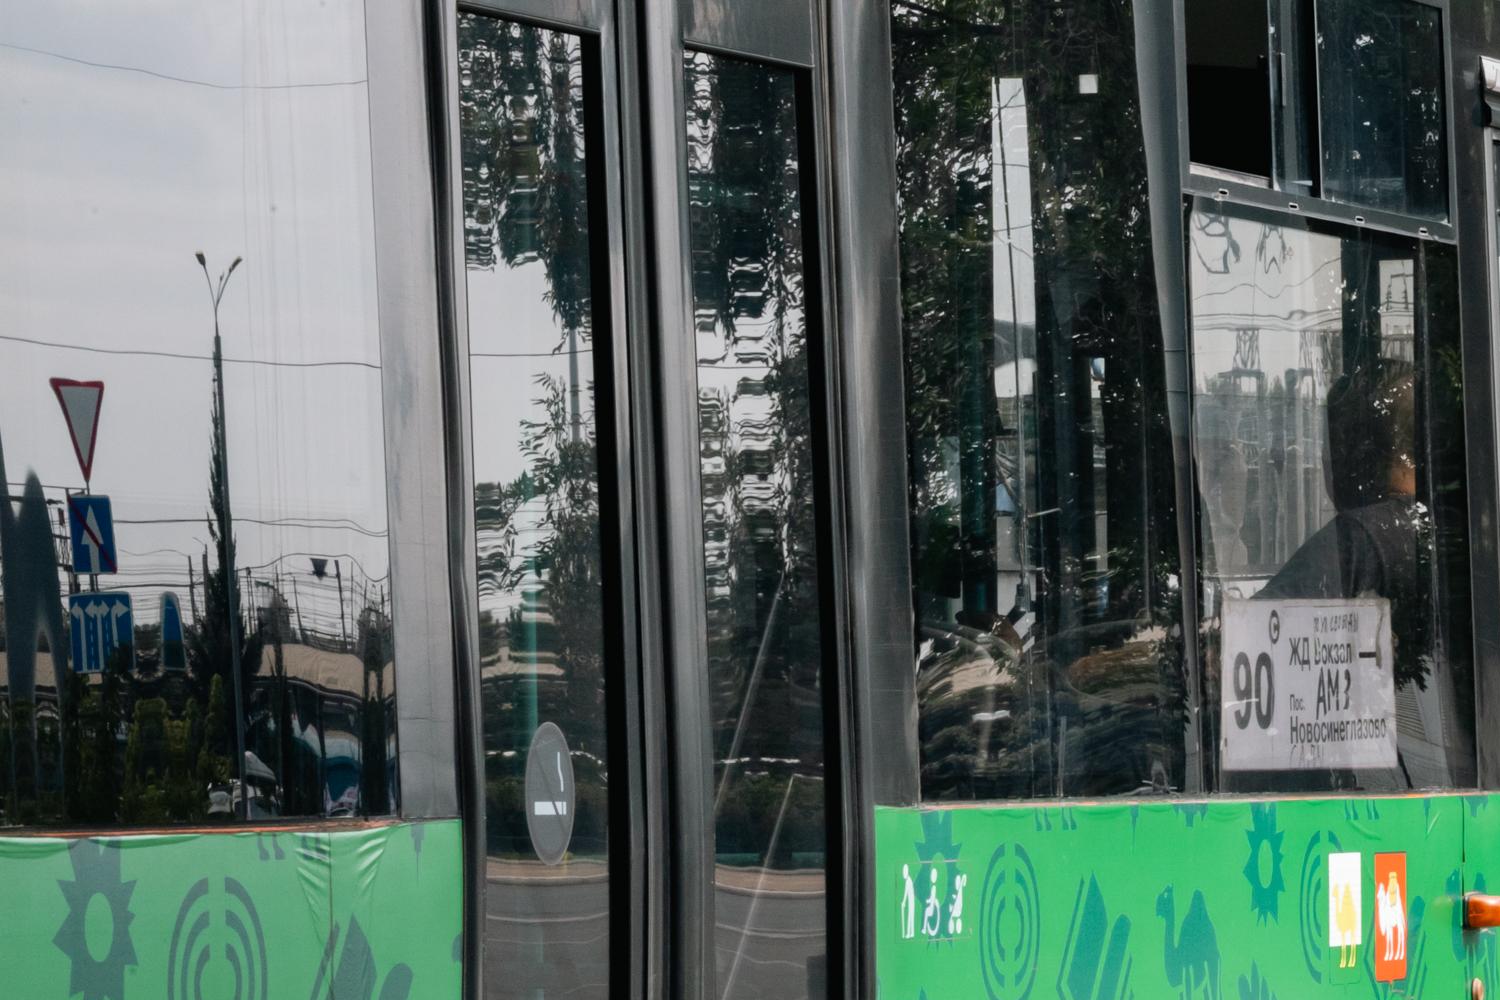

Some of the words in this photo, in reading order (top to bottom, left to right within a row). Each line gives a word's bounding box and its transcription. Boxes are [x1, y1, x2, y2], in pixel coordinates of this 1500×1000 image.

[1289, 637, 1310, 671] ЖД
[1233, 651, 1275, 730] 90
[1289, 716, 1387, 745] Новосинеглазово
